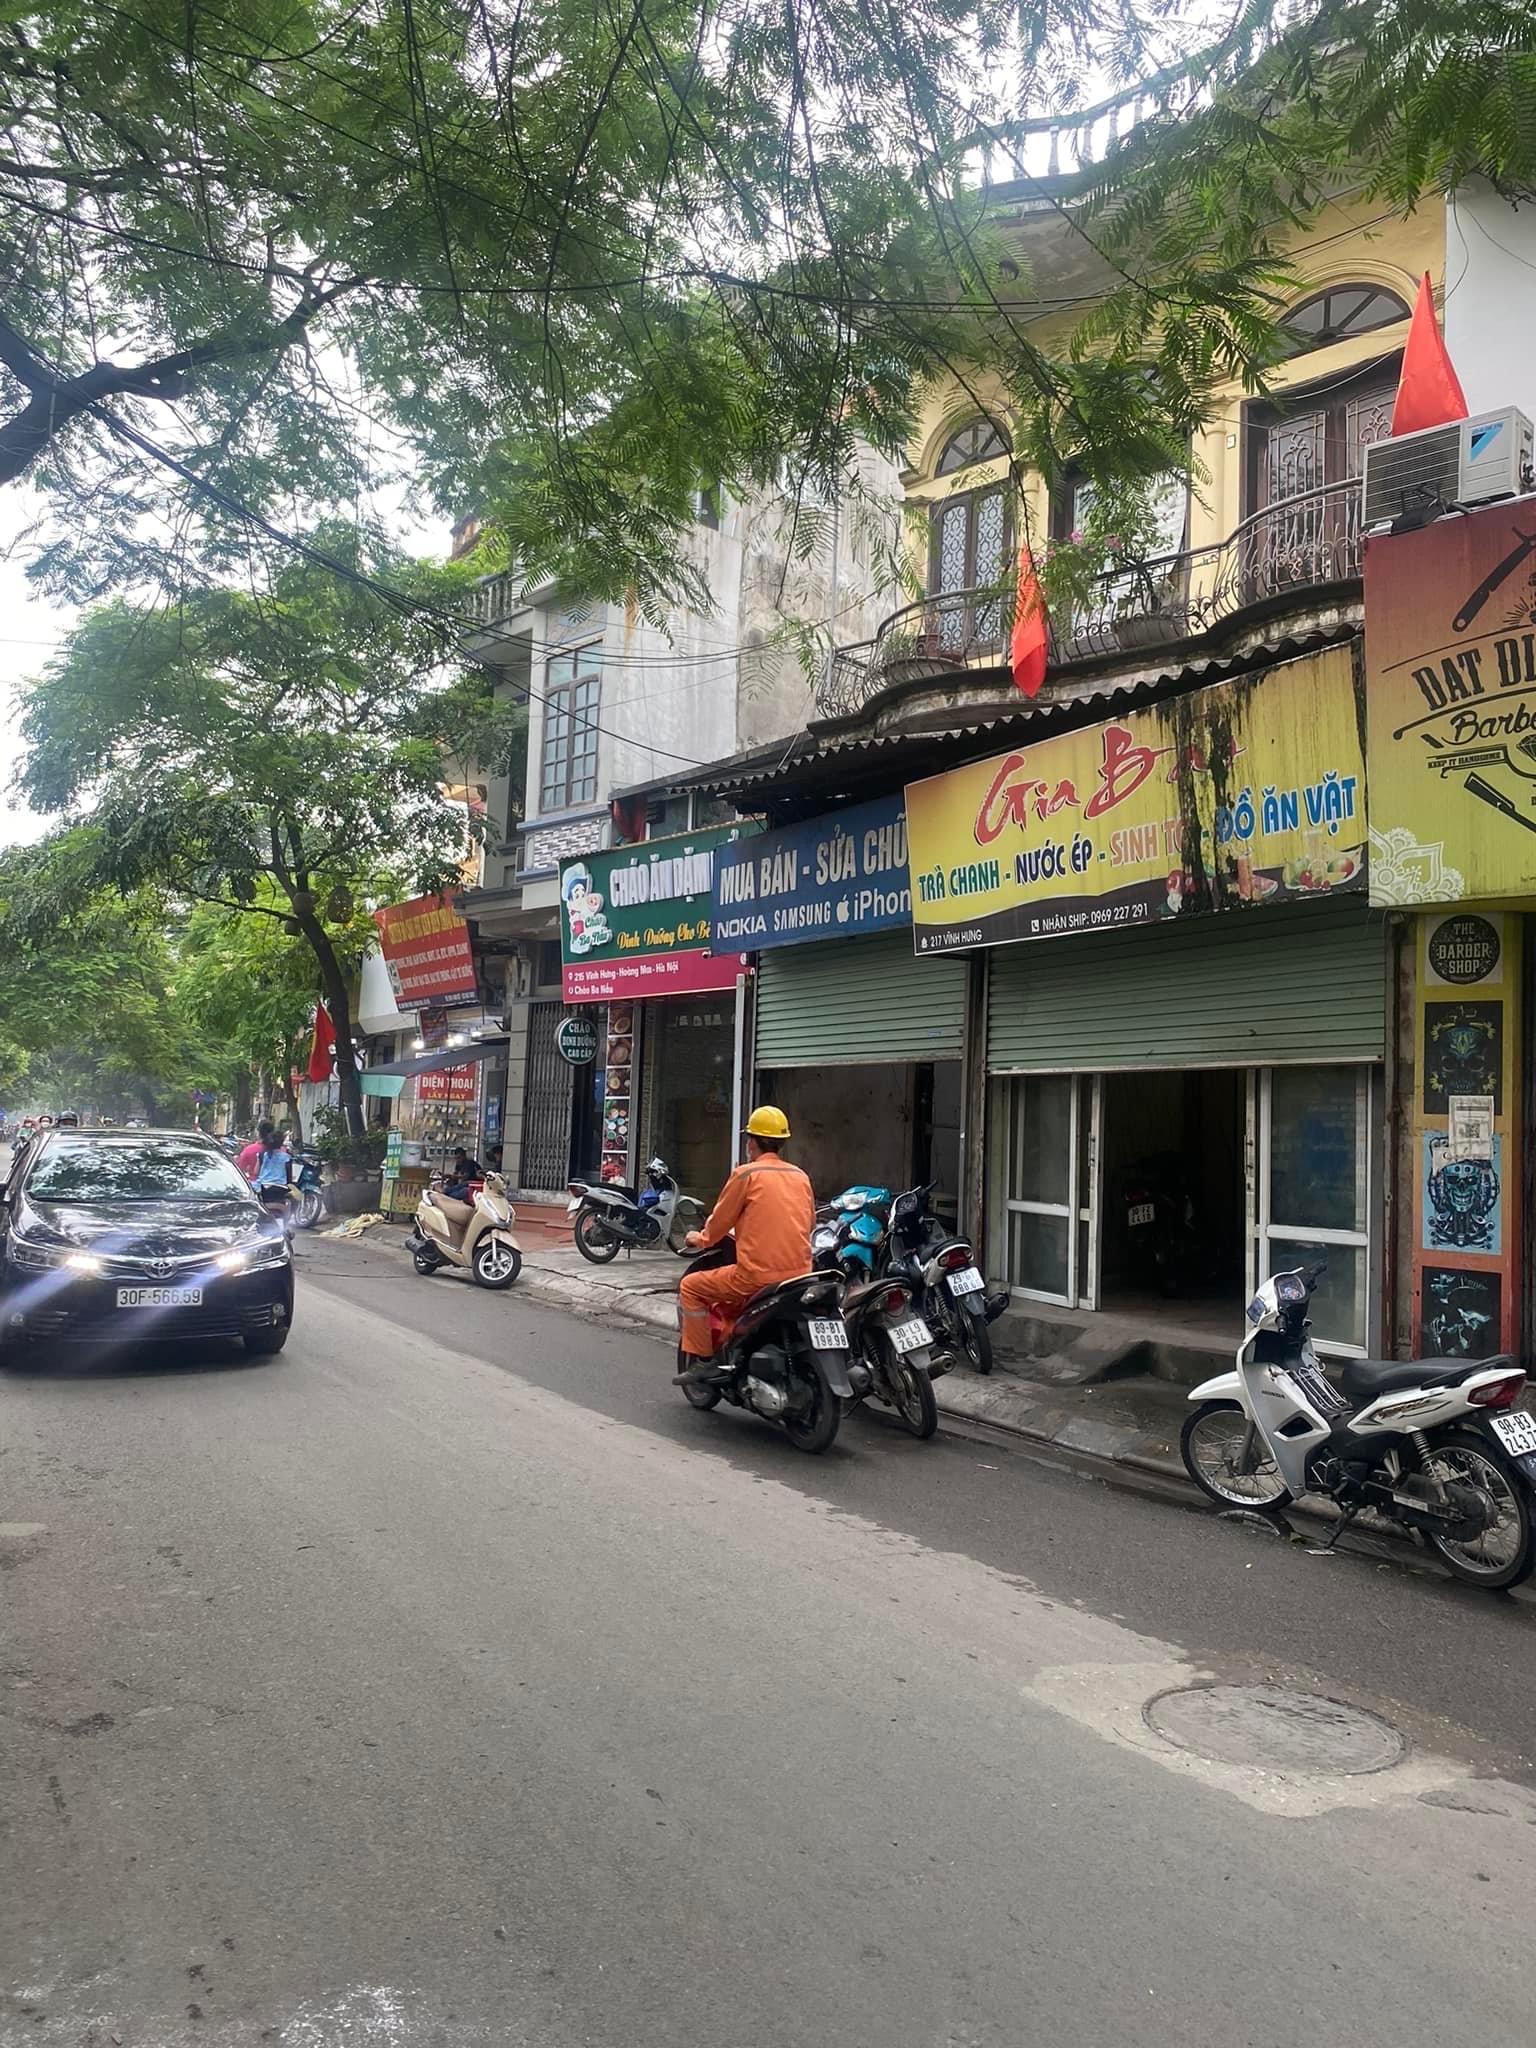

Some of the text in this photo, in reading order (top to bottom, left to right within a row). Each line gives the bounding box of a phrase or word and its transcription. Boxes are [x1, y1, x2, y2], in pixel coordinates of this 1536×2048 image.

[1411, 648, 1485, 711] DAT
[975, 755, 1081, 845] Gia
[919, 866, 945, 902] TRÀ
[950, 860, 1000, 896] CHANH
[1016, 840, 1066, 884] NƯỚC
[1070, 833, 1092, 873] ÉP
[1110, 825, 1158, 866] SINH
[1263, 786, 1299, 834] ĂN
[1304, 770, 1357, 836] VẶT
[719, 862, 755, 905] MUA
[759, 844, 798, 897] BÁN
[816, 824, 857, 886] SỬA
[610, 858, 650, 907] CHÁO
[717, 915, 767, 939] NOKIA
[773, 901, 831, 931] SAMSUNG
[1042, 903, 1148, 932] NHẬN SHIP: 0969 227 291
[677, 923, 695, 942] Cho
[1453, 922, 1475, 935] THE
[930, 935, 942, 947] 217
[1439, 943, 1490, 959] BARBER
[1449, 959, 1480, 974] SHOP
[569, 1021, 590, 1033] CHÁO
[119, 1289, 201, 1305] 30F-566.59
[899, 1335, 927, 1350] 2634
[1497, 1415, 1531, 1435] 98-B3
